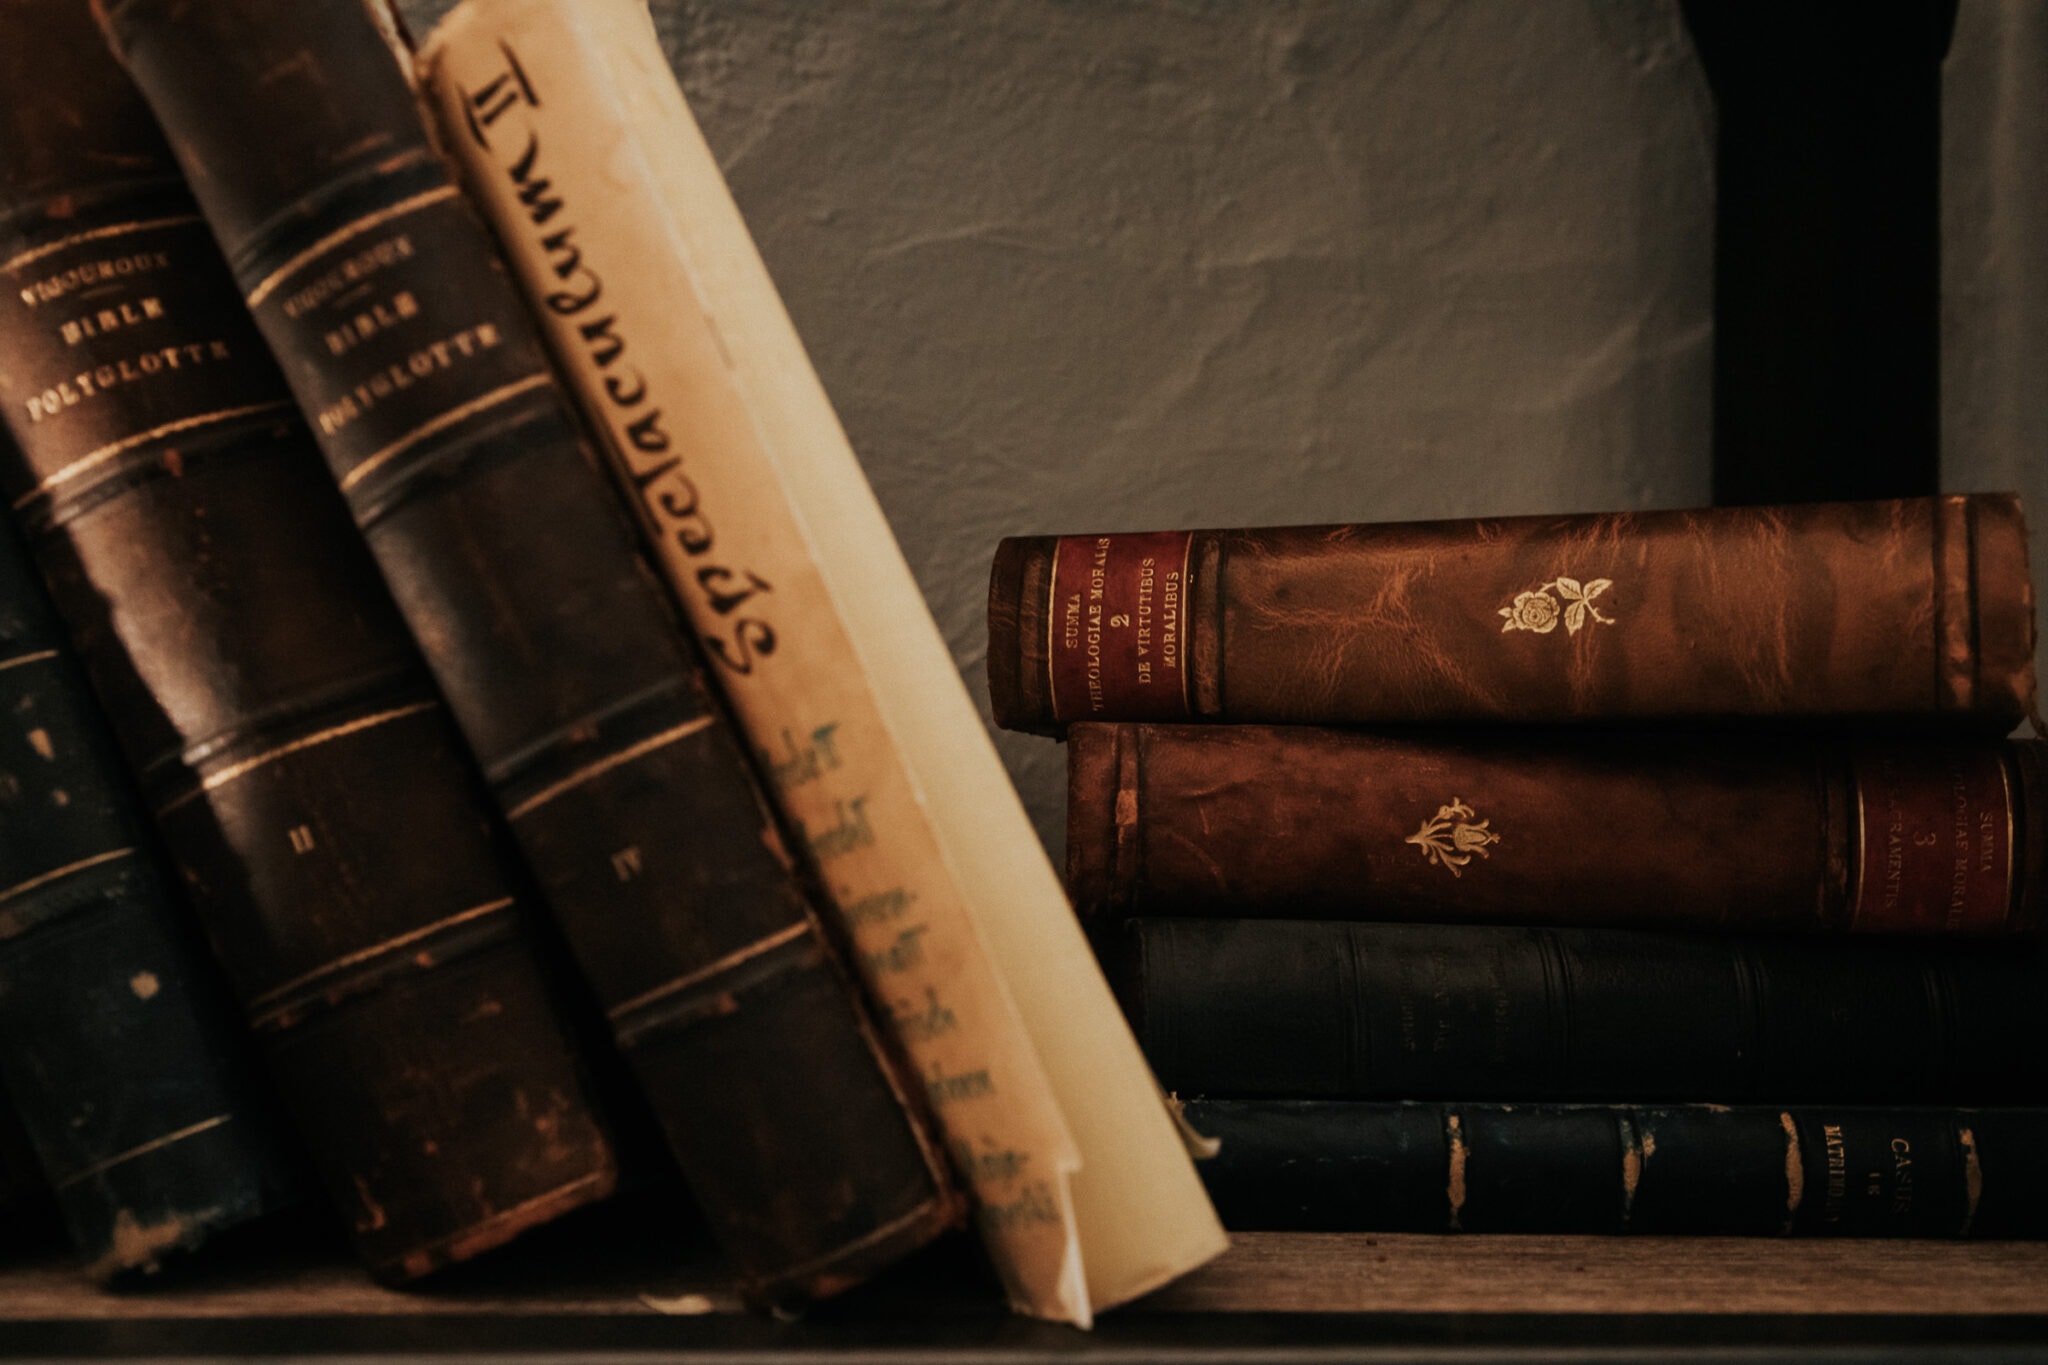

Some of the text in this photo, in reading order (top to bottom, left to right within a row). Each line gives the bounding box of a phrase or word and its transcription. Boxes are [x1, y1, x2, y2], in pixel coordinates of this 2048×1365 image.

[456, 39, 538, 150] II
[59, 296, 167, 347] BIBLE
[325, 289, 421, 356] BIBLE
[25, 337, 232, 423] POLYGLOTTE
[1066, 593, 1081, 650] SUMMA
[1087, 537, 1110, 712] THEOLOGIAE MORALIS
[1109, 613, 1130, 629] 2
[1137, 557, 1155, 685] DE VIRTUTIBUS
[1162, 571, 1179, 668] MORALIBUS
[1912, 829, 1937, 848] 3
[1979, 811, 1994, 873] SUMMA
[1889, 1137, 1914, 1216] CASUS
